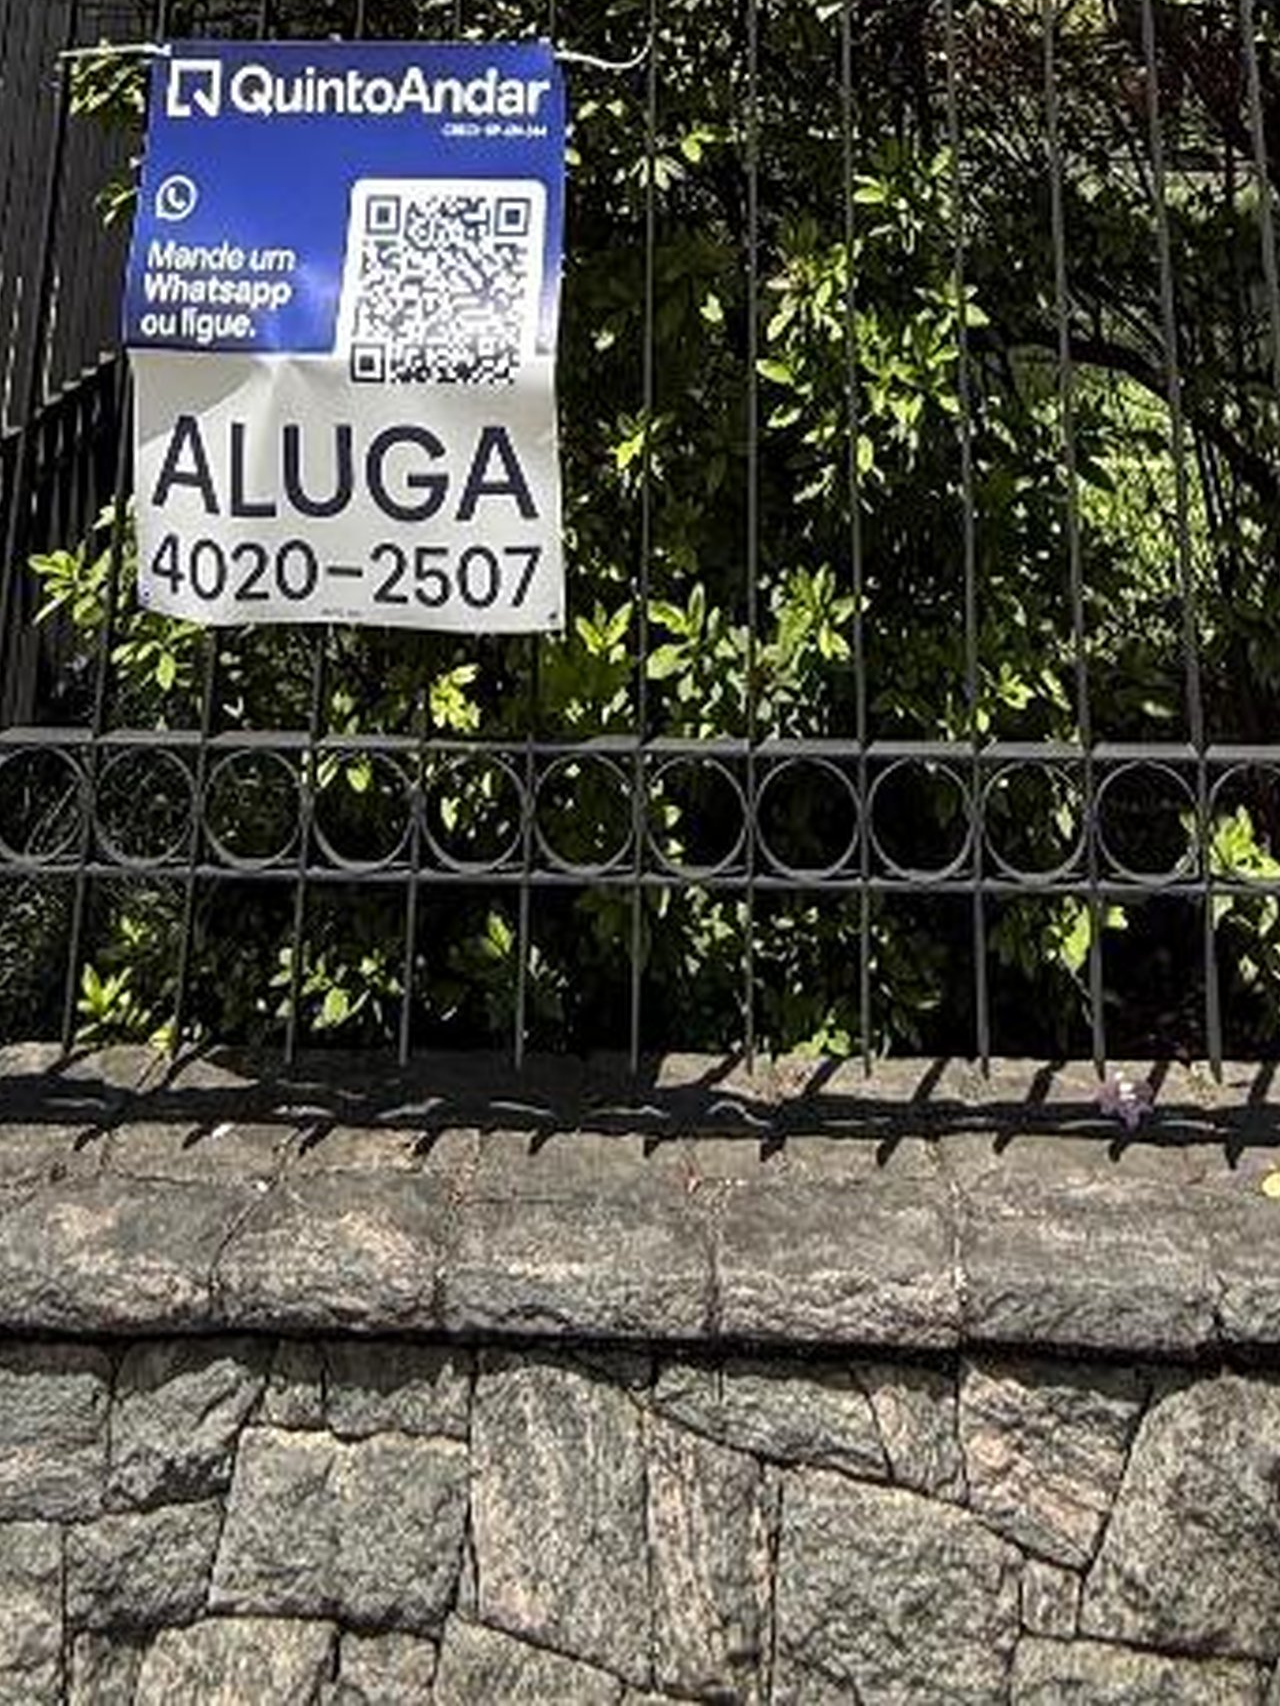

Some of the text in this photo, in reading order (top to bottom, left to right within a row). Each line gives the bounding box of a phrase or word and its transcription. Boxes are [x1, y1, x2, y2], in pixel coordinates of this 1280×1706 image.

[231, 65, 550, 116] QuintoAndar
[148, 239, 296, 272] Mande um
[144, 272, 292, 310] Whatsapp
[140, 306, 256, 345] ou ligue.
[151, 414, 540, 523] ALUGA
[151, 534, 543, 610] 4020-2507
